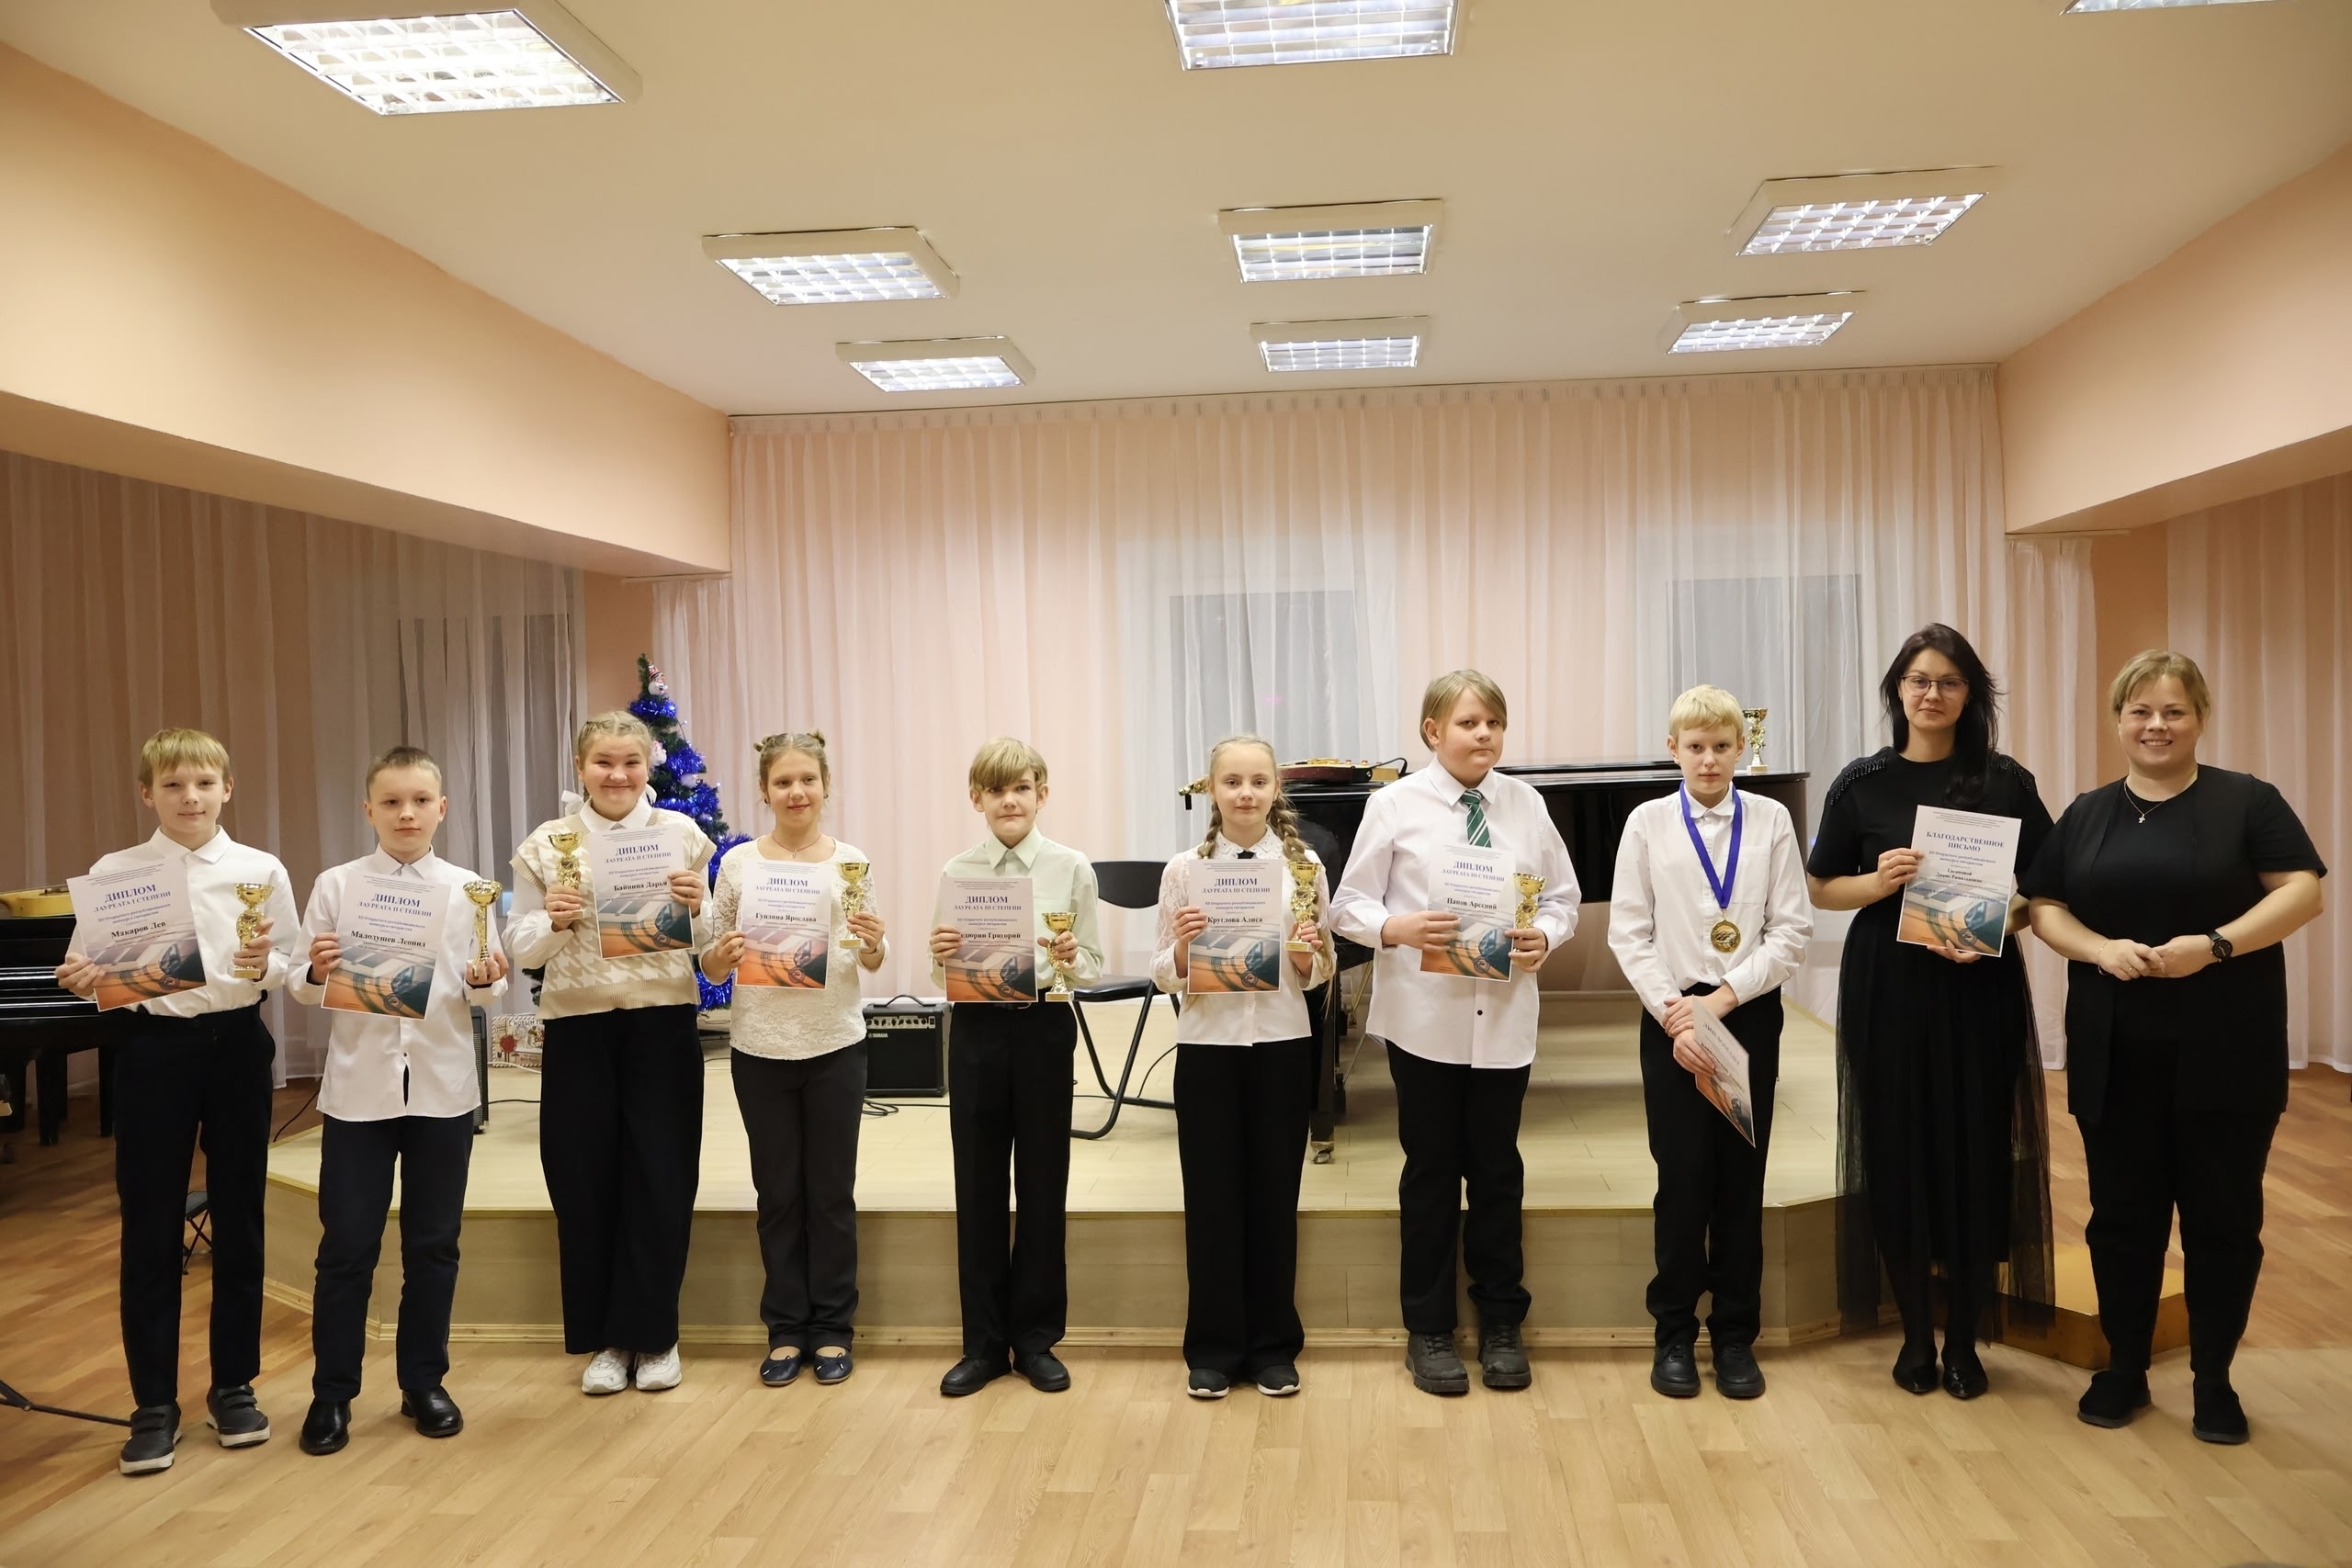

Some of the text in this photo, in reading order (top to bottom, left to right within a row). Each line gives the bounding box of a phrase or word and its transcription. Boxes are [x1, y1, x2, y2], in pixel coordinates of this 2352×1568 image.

[1927, 831, 2005, 848] БЛАГОДАРСТВЕННОЕ
[616, 844, 659, 856] ДИПЛОМ
[1948, 842, 1980, 852] ПИСЬМО
[1453, 862, 1493, 873] ДИПЛОМ
[767, 877, 808, 887] ДИПЛОМ
[1215, 878, 1257, 886] ДИПЛОМ
[1478, 874, 1504, 882] СТЕПЕНИ
[646, 881, 667, 889] Дарья
[105, 885, 156, 903] ДИПЛОМ
[966, 896, 1007, 904] ДИПЛОМ
[93, 900, 130, 912] ЛАУРЕАТА
[136, 891, 171, 903] СТЕПЕНИ
[372, 894, 420, 907] ДИПЛОМ
[1447, 897, 1497, 909] Панов Арсений
[357, 901, 391, 911] ЛАУРЕАТА
[400, 908, 432, 917] СТЕПЕНИ
[111, 926, 149, 938] Макаров
[151, 921, 166, 930] Лев
[351, 931, 425, 948] Малодушев Леонид
